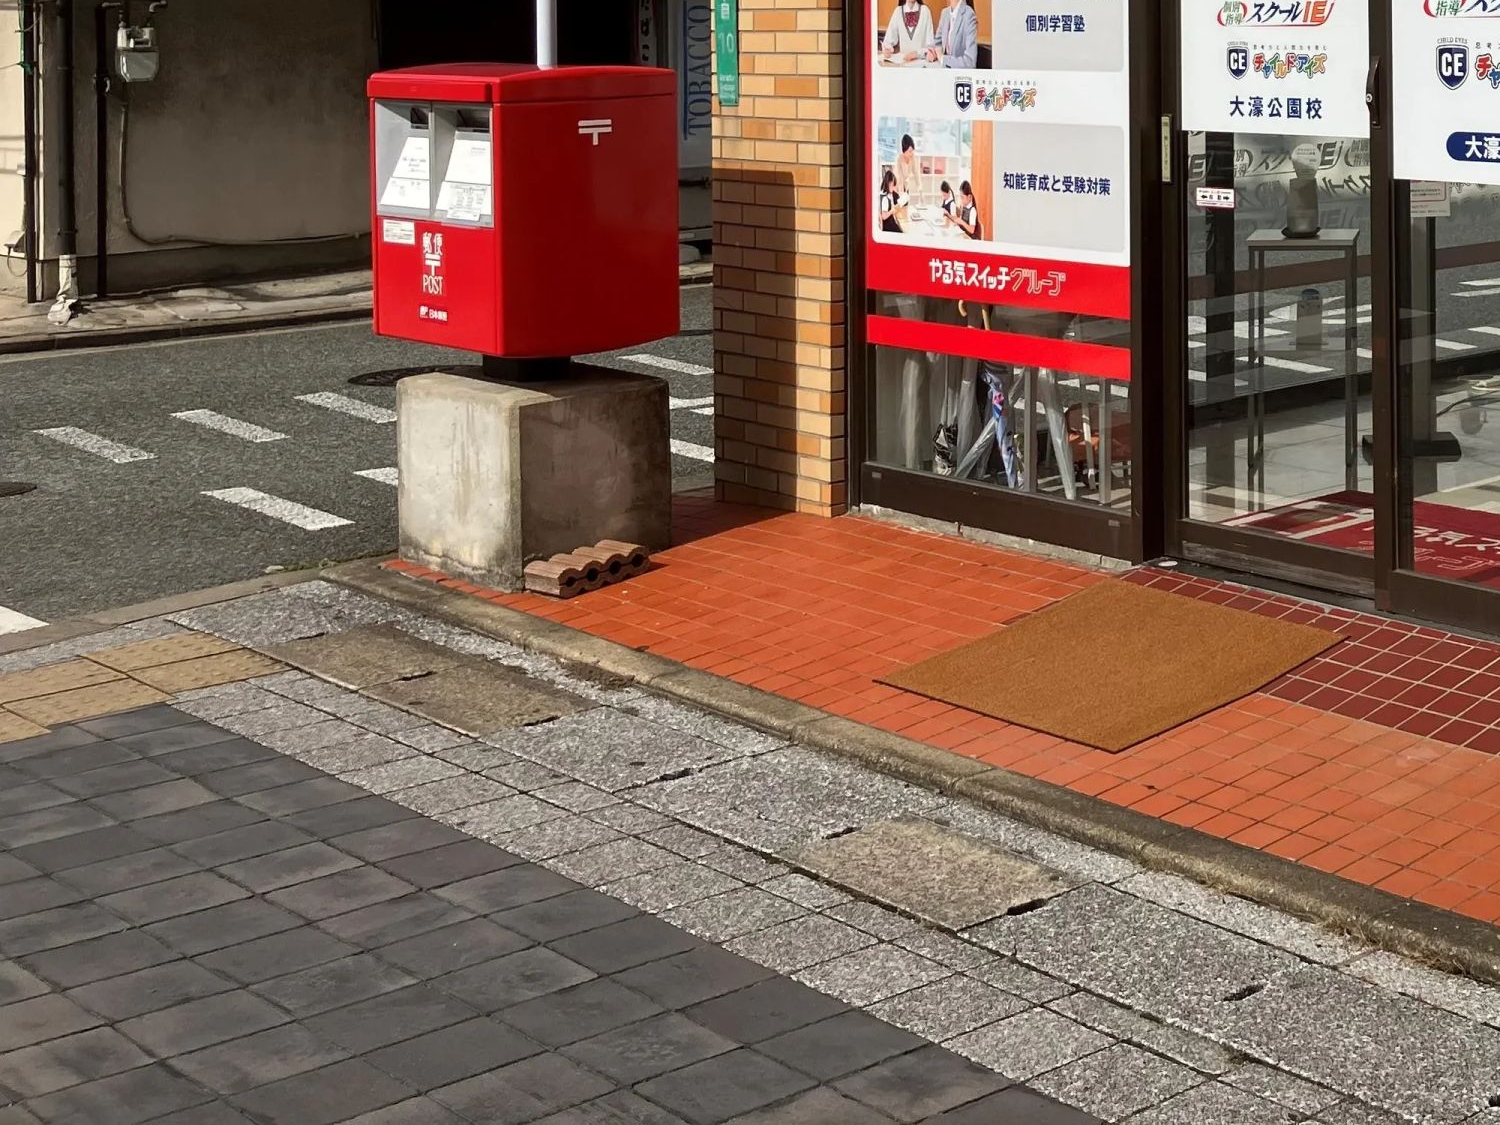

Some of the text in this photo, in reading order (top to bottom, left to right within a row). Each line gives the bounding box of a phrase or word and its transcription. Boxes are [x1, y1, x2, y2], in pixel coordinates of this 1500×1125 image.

[1247, 0, 1329, 24] スクールIE
[1435, 0, 1462, 16] 指導
[1025, 15, 1085, 32] 個別学習塾
[1230, 50, 1246, 70] CE
[1440, 52, 1464, 77] CE
[956, 85, 970, 103] CE
[1229, 95, 1323, 120] 大濠公園校
[1003, 172, 1111, 196] 知能育成と受験対策
[423, 232, 443, 255] 郵便
[423, 274, 443, 295] POST
